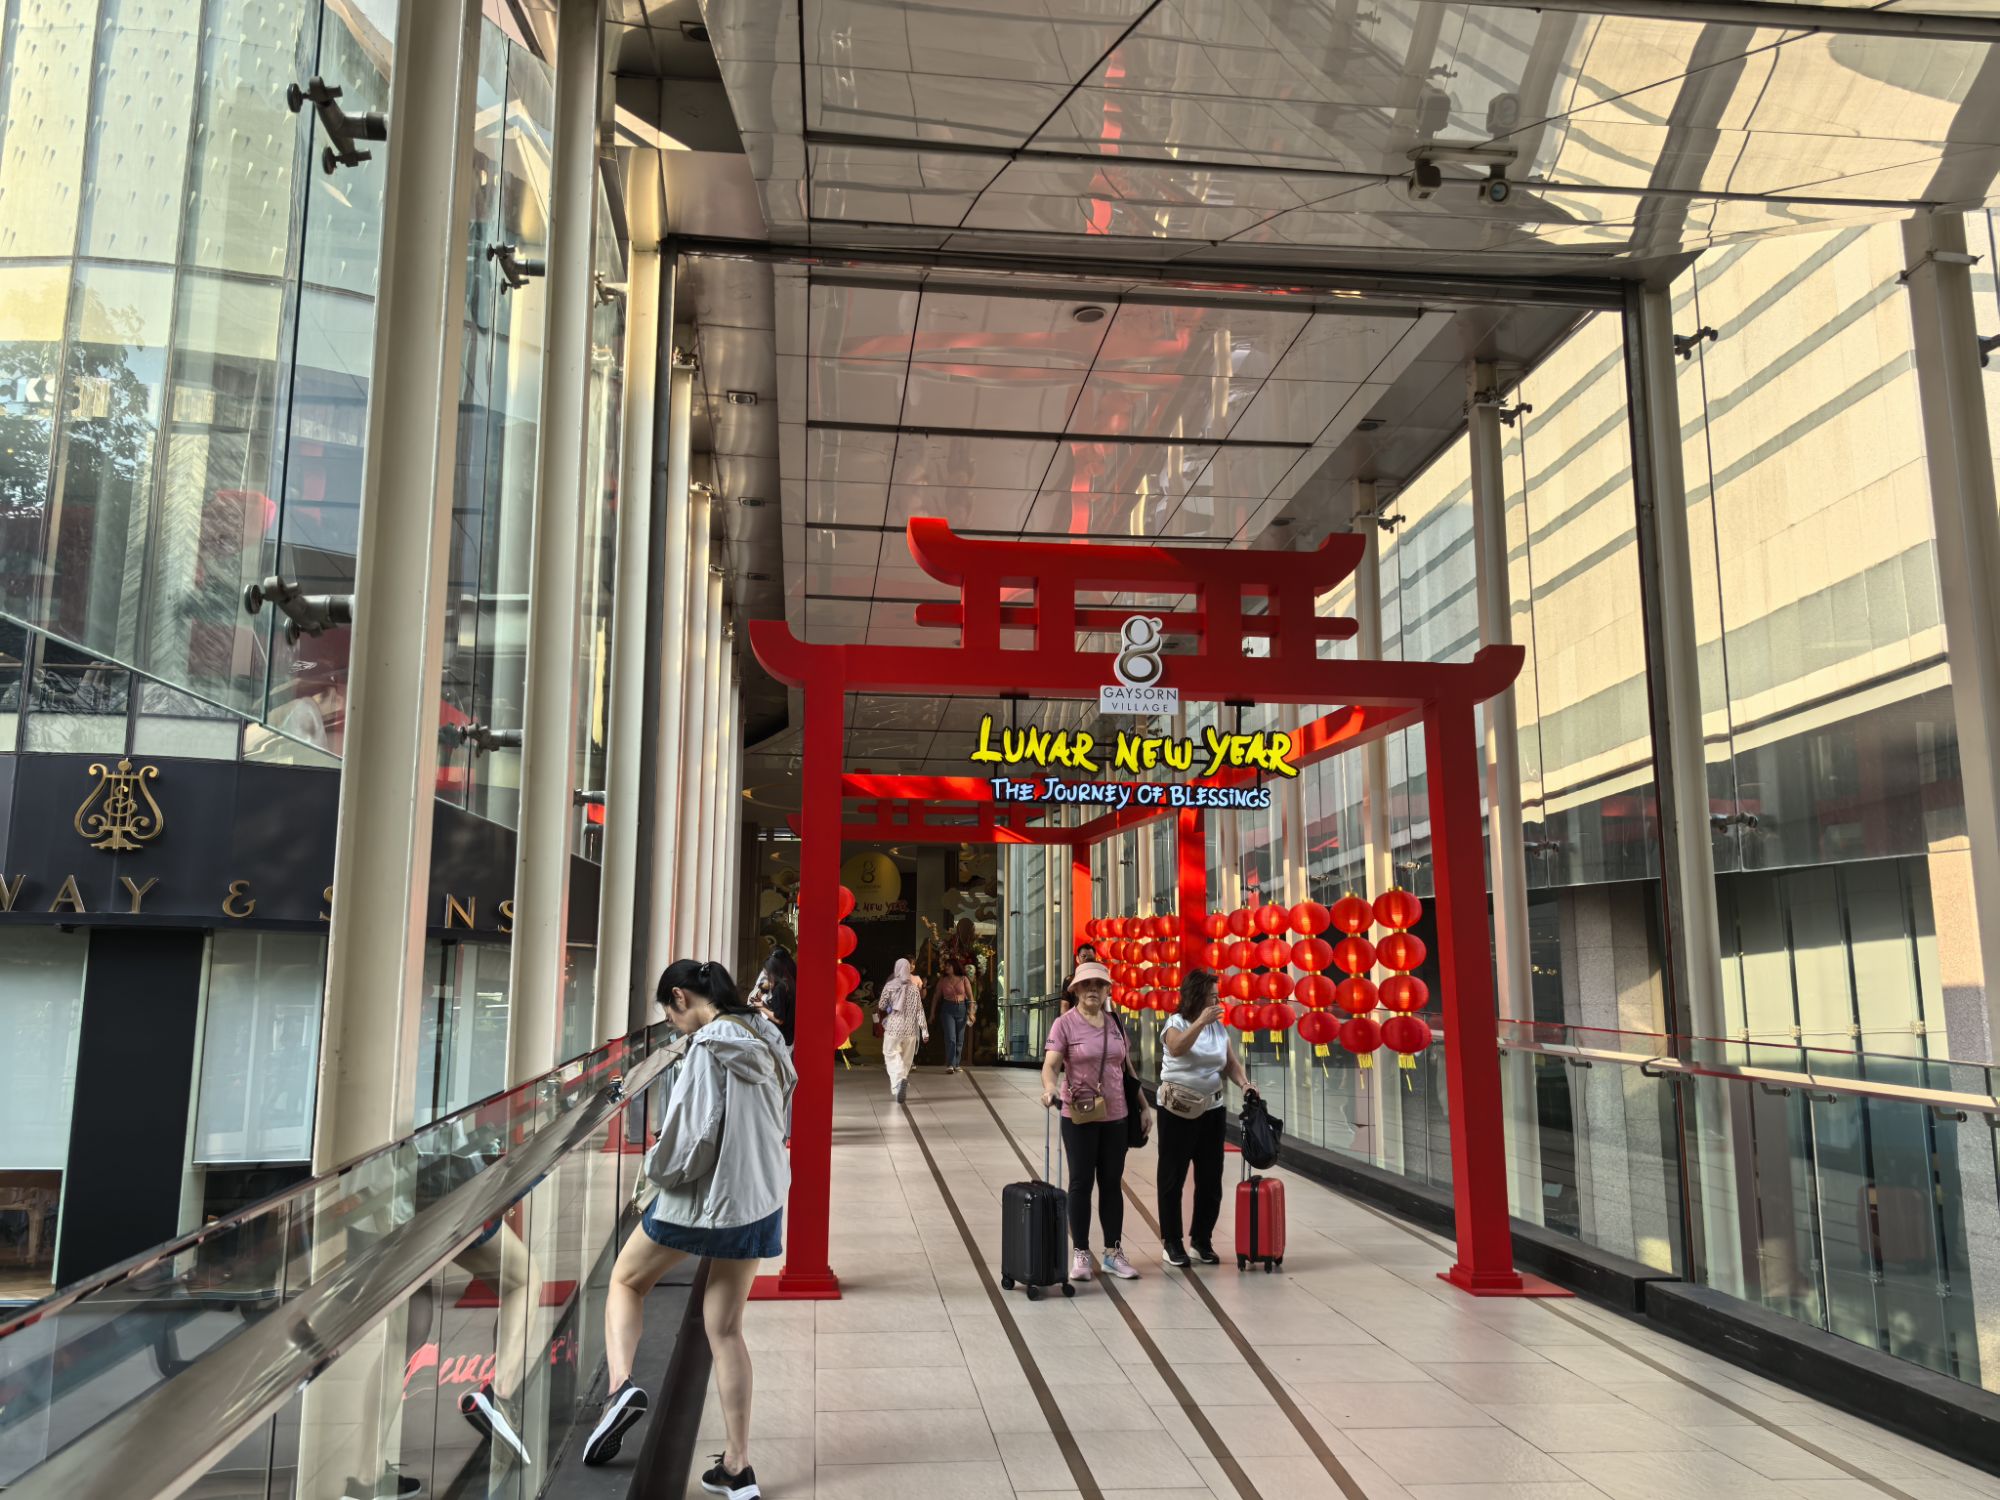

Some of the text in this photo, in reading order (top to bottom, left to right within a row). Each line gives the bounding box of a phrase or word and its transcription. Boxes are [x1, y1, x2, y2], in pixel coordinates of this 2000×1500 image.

[1103, 687, 1177, 700] GAYSORN
[1111, 702, 1168, 712] VILLAGE
[970, 714, 1300, 777] LUNAR NEW YEAR
[990, 777, 1271, 810] THE JOURNEY OF BLESSINGS
[222, 880, 256, 918] &
[319, 886, 515, 933] NS
